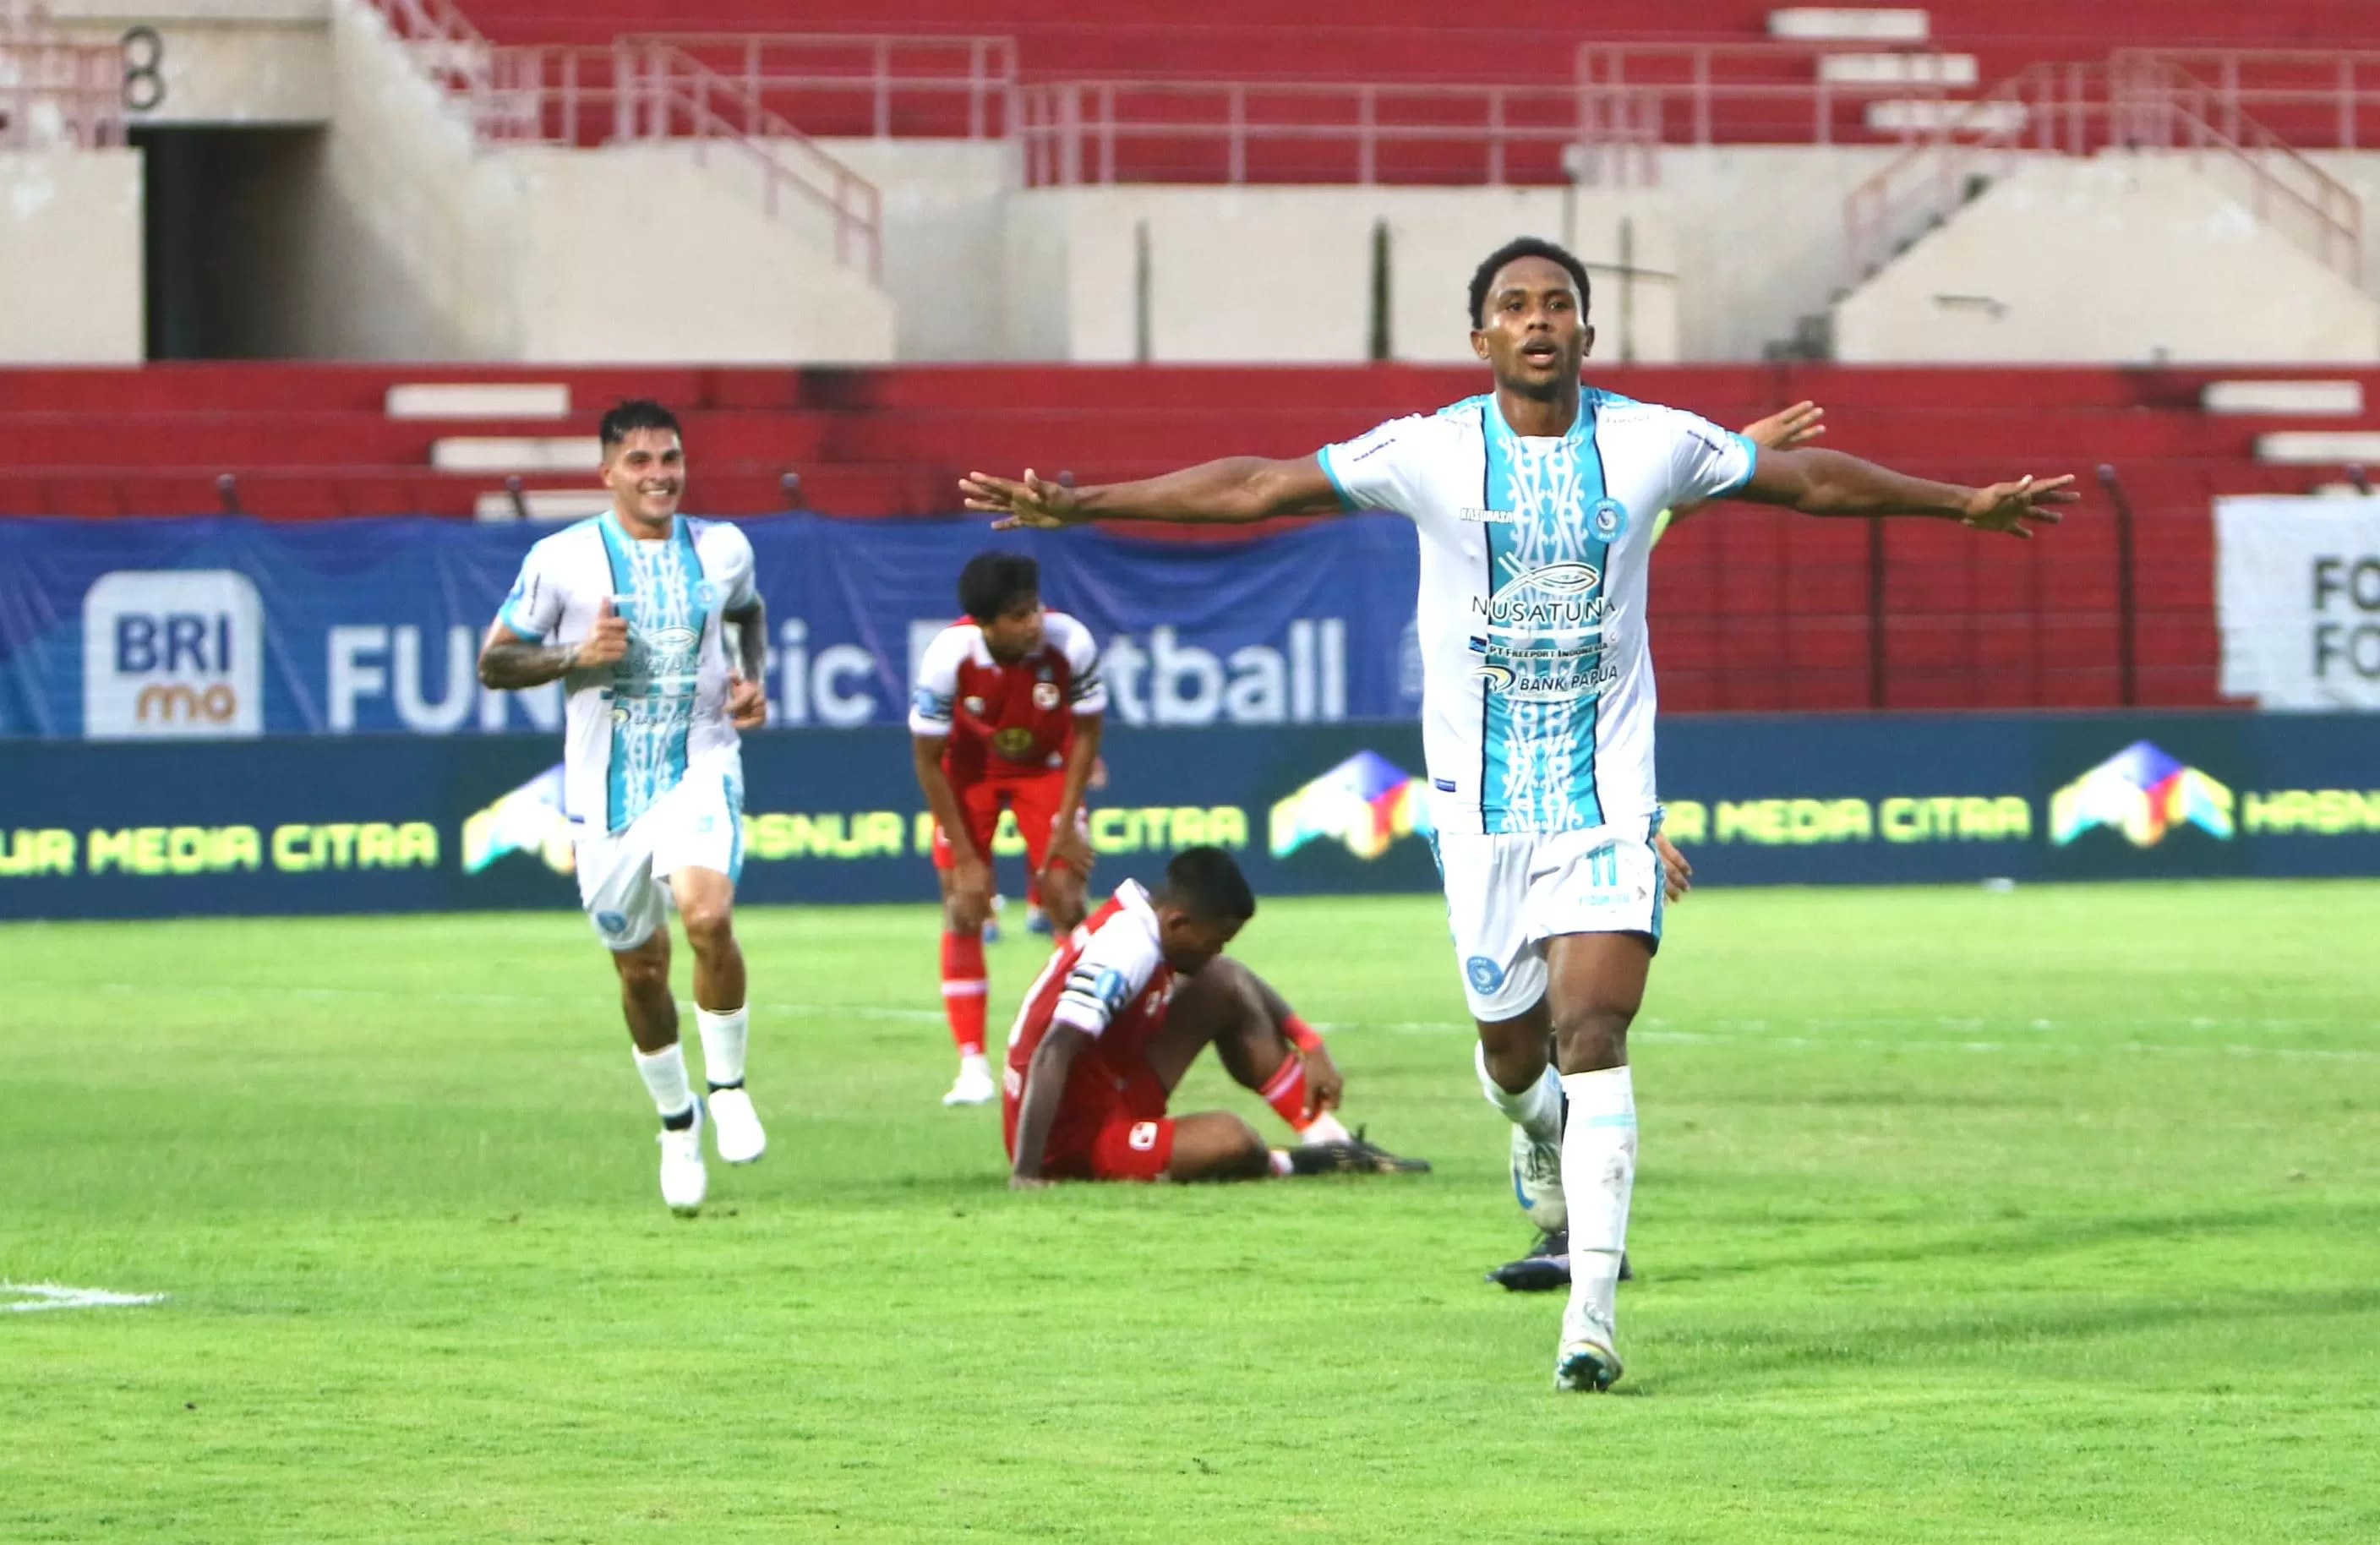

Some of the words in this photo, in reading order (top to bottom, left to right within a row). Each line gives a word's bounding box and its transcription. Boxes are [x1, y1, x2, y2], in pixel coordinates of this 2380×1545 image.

[1472, 595, 1616, 622] NUSATUNA
[115, 613, 232, 673] BRI
[1520, 678, 1564, 691] BANK
[1571, 666, 1618, 688] PAPUA
[137, 683, 237, 723] mo
[1091, 806, 1248, 854] CITRA
[1715, 798, 1873, 843] MEDIA
[1879, 795, 2033, 843] CITRA
[88, 827, 262, 875] MEDIA
[272, 822, 439, 872] CITRA
[1586, 843, 1617, 887] 11
